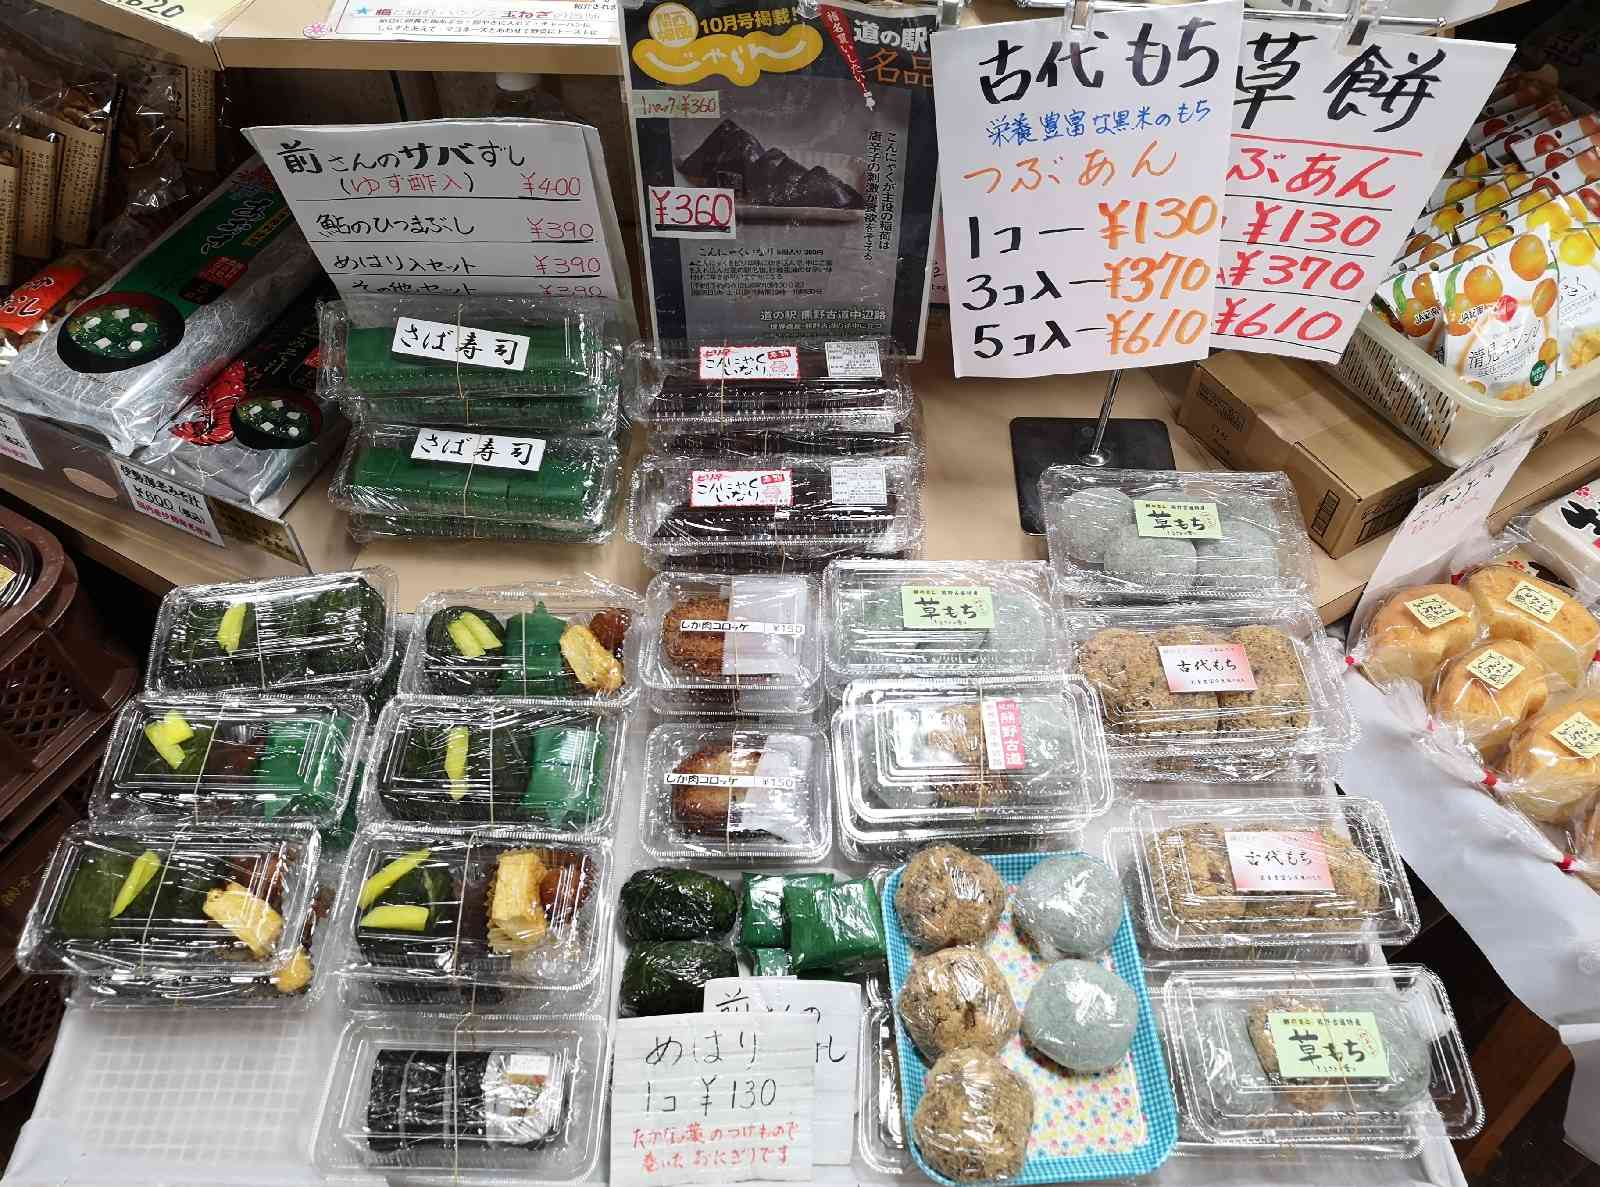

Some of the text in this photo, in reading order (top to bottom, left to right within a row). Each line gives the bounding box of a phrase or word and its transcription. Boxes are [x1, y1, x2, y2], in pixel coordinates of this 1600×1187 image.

[853, 19, 929, 54] 道の駅
[864, 47, 933, 88] 名品
[979, 16, 1220, 105] 古代もち
[1233, 31, 1447, 133] 草餅
[682, 95, 717, 116] ¥360
[986, 99, 1212, 148] 栄養豊富な黒米のもち
[277, 140, 525, 174] 前さんのサバずし
[964, 140, 1177, 194] つぶあん
[520, 172, 581, 197] ¥400
[651, 189, 733, 226] ¥360
[1242, 200, 1381, 247] ¥130
[316, 213, 475, 239] 鮎のひつまぶし
[526, 216, 595, 239] ¥390
[333, 255, 601, 275] めはり入セット ¥390
[1229, 249, 1366, 291] ¥370
[540, 284, 603, 298] ¥390
[1214, 296, 1344, 341] ¥610
[400, 323, 518, 366] さば寿司
[704, 353, 767, 369] こんにゃく
[420, 433, 534, 466] さば寿司
[697, 478, 759, 494] こんにゃく
[1146, 509, 1206, 531] 草もち
[913, 597, 977, 620] 草もち
[1177, 657, 1238, 673] 古代もち
[645, 1029, 758, 1071] めはり
[1288, 1028, 1366, 1064] 草もち
[700, 1074, 778, 1117] ¥130
